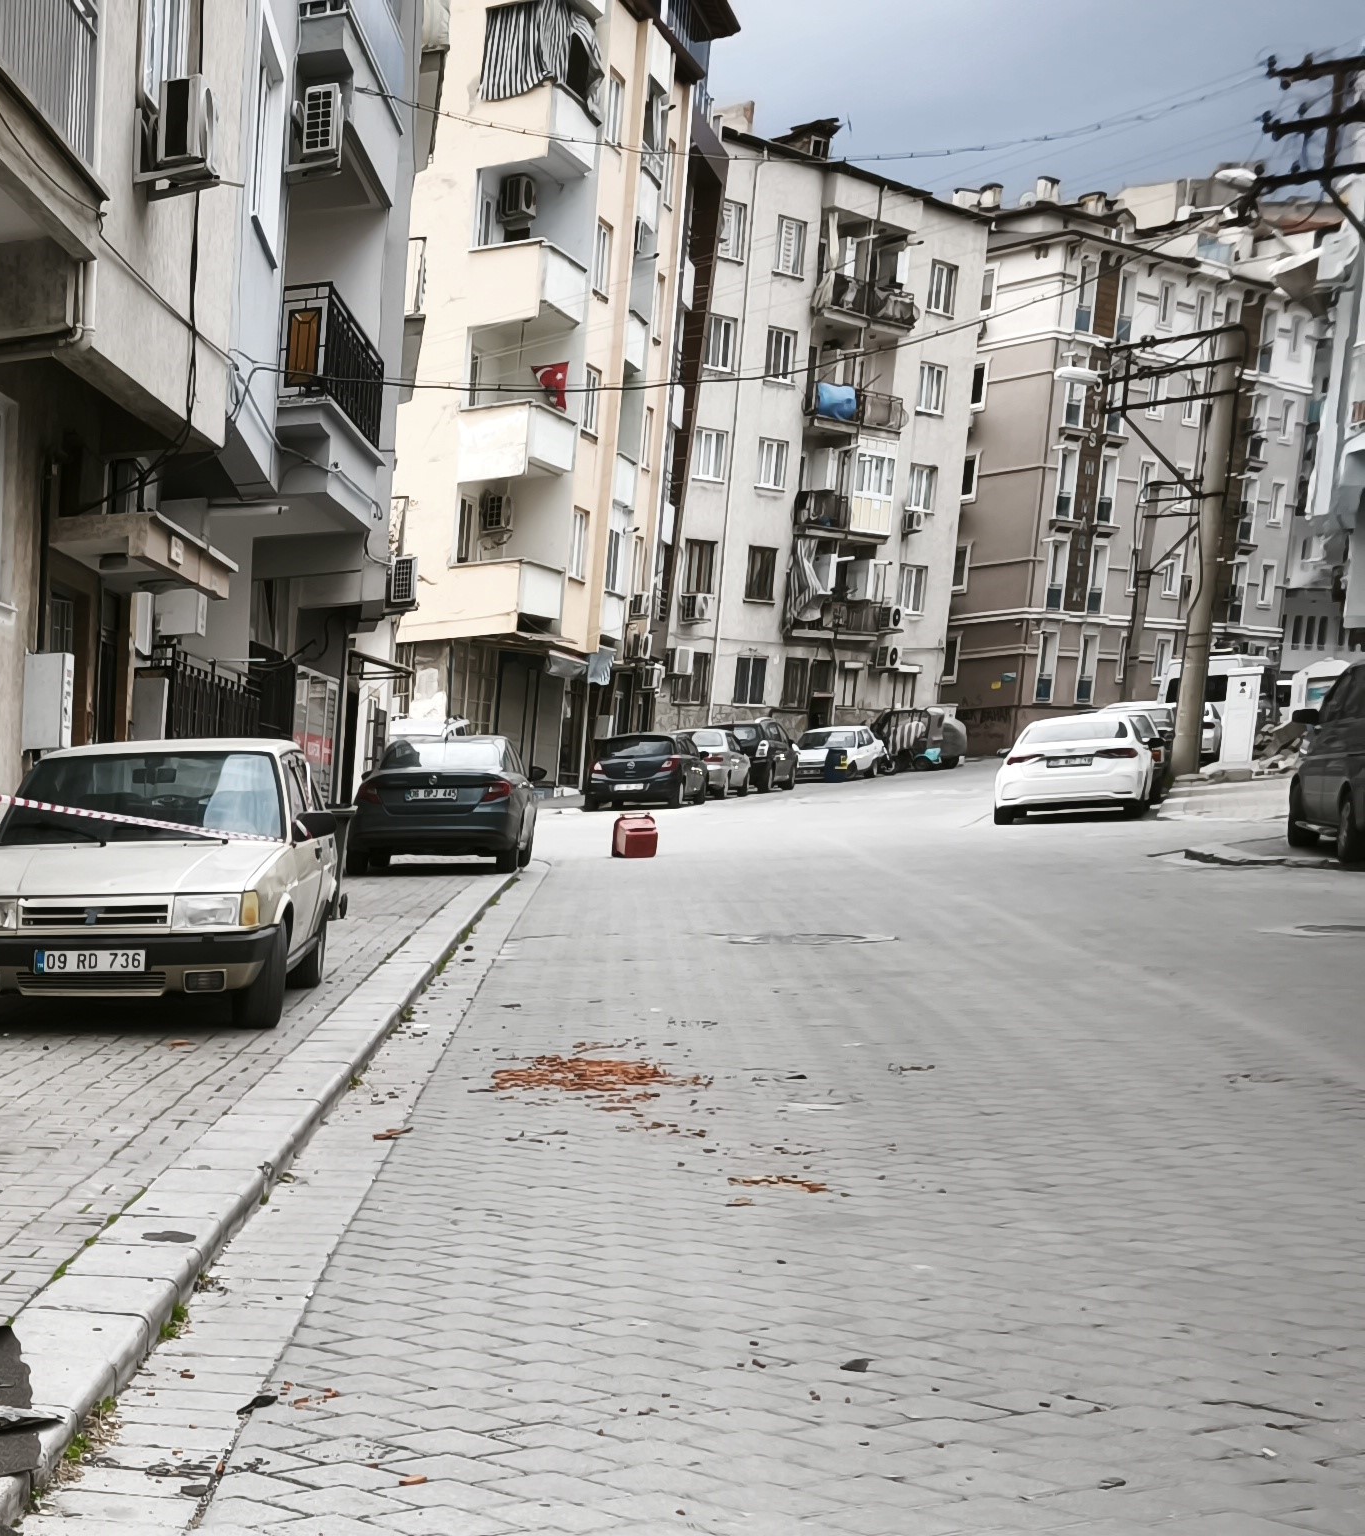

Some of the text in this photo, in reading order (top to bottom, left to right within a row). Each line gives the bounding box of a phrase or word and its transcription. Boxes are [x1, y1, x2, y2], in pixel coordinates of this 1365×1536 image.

[46, 953, 67, 970] 09
[76, 953, 98, 970] RD
[109, 952, 141, 969] 736
